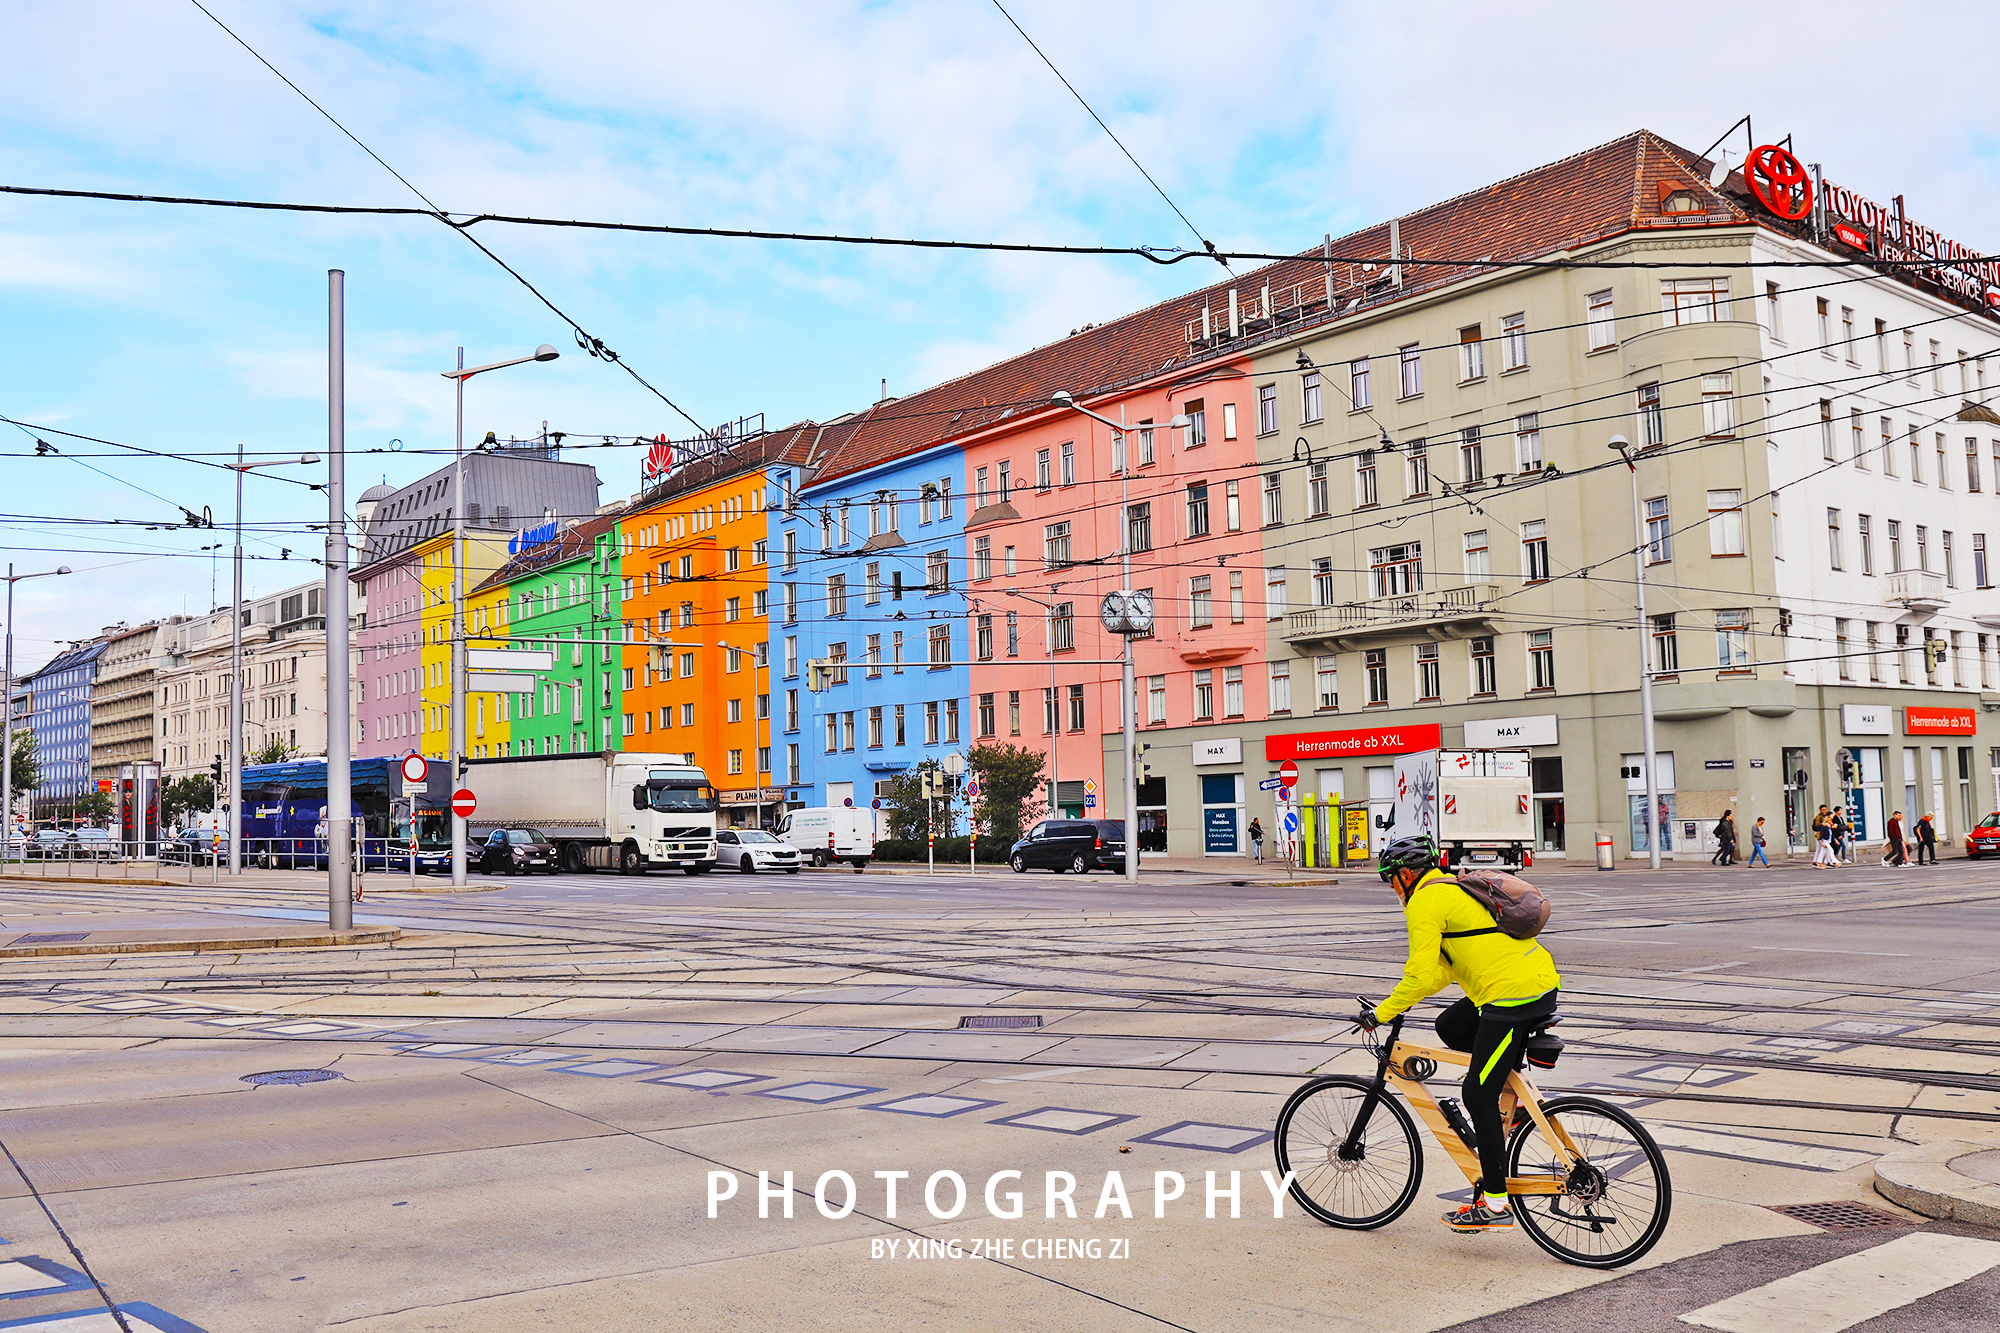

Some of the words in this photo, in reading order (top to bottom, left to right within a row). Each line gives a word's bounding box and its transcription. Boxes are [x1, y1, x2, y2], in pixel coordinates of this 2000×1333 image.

[1822, 179, 1896, 241] TOYOTA
[1940, 269, 1982, 301] SERVICE
[1862, 715, 1875, 723] MAX
[1911, 715, 1950, 728] Herrenmode
[1951, 716, 1959, 728] ab
[1960, 716, 1973, 728] XXL
[1497, 727, 1520, 737] MAX
[1296, 738, 1361, 752] Herrenmode
[1364, 736, 1378, 748] ab
[1381, 735, 1404, 747] XXL
[1207, 747, 1224, 755] MAX
